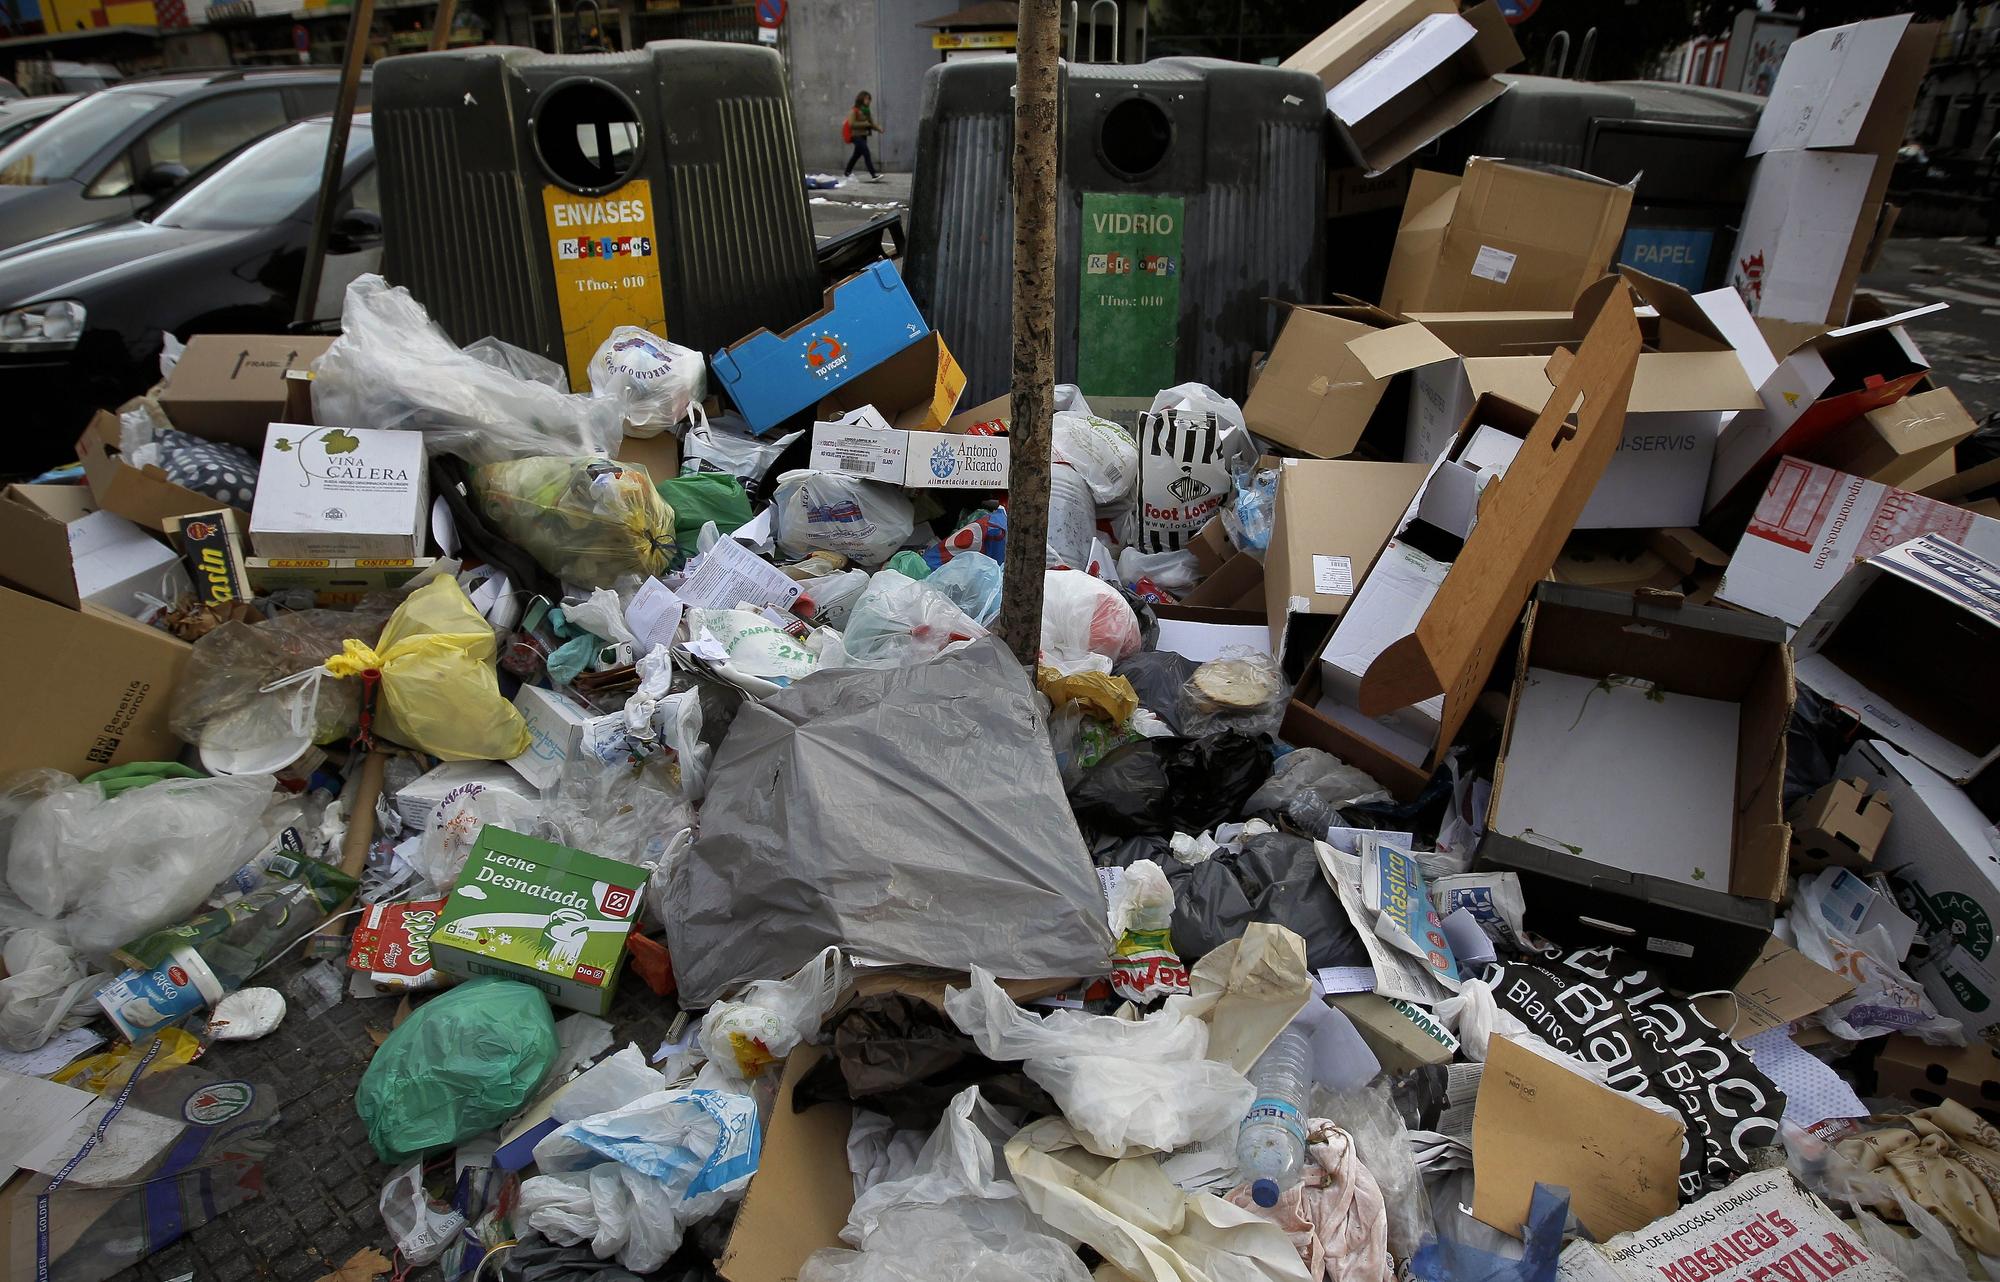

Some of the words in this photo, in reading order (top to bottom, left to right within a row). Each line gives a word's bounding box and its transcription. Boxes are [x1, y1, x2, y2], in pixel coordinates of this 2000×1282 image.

[553, 200, 645, 227] ENVASES
[1092, 213, 1174, 235] VIDRIO
[1633, 244, 1696, 264] PAPEL
[623, 276, 645, 288] 010
[1140, 295, 1164, 307] 010
[628, 363, 672, 380] MERCADO
[826, 354, 848, 371] VICENT
[957, 441, 998, 458] Antonio
[1615, 435, 1696, 451] I-SERVIS
[328, 455, 364, 467] VIÑA
[956, 459, 964, 475] y
[965, 456, 1003, 473] Ricardo
[326, 466, 409, 481] CALERA
[928, 478, 970, 486] Alimentación
[1145, 502, 1180, 521] Foot
[1814, 476, 1865, 570] ruponortenos.com
[739, 625, 774, 638] PARA
[115, 683, 151, 736] Pecoraro
[484, 850, 537, 873] Leche
[475, 866, 590, 911] Desnatada
[152, 971, 179, 1000] GRIEGO
[1390, 998, 1454, 1050] APPYDENT
[48, 1164, 73, 1192] OLDEN
[39, 1196, 48, 1233] GOLDEN
[1609, 1243, 1648, 1264] ABRICA
[1647, 1236, 1665, 1250] DE
[1662, 1211, 1716, 1242] BALDOSAS
[1714, 1180, 1779, 1217] HIDRAULICAS
[1658, 1208, 1799, 1282] MOSAICO'S
